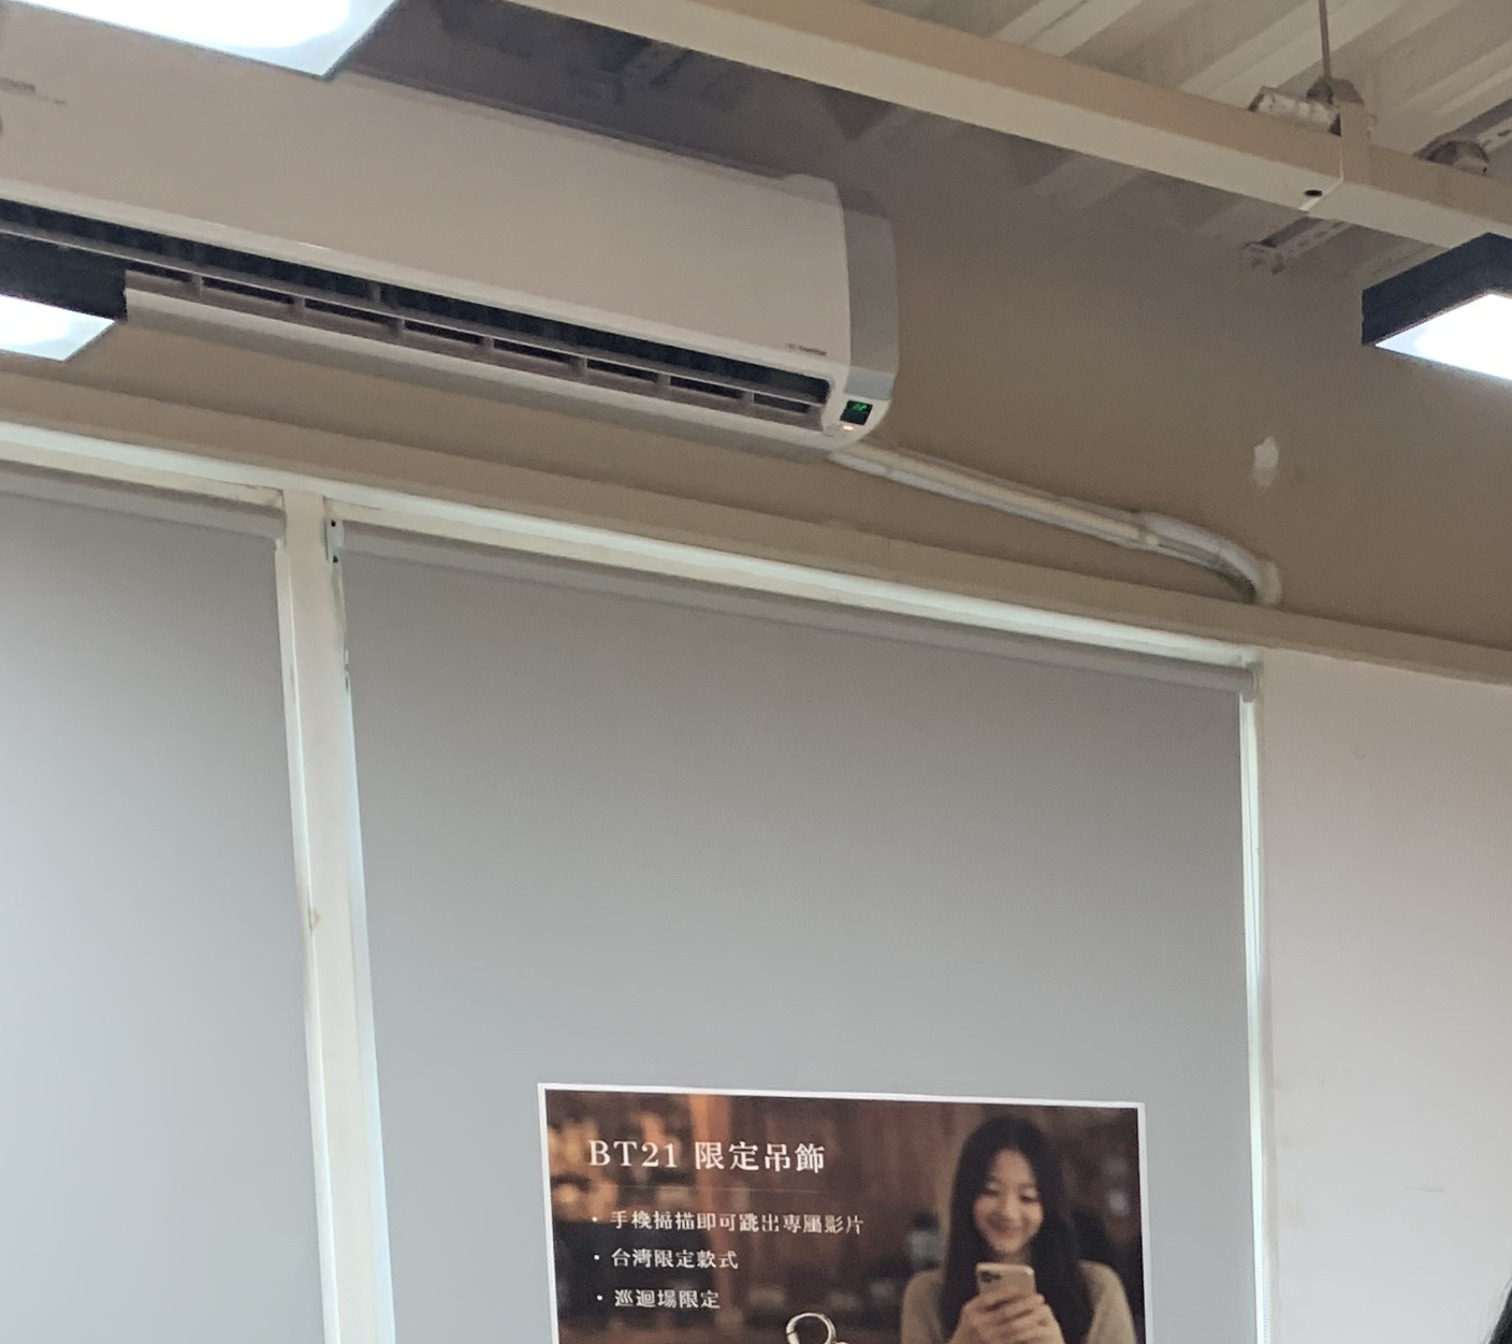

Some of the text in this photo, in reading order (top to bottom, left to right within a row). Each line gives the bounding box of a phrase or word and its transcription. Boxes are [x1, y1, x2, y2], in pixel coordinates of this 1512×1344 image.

[588, 1139, 825, 1173] BT21 限定吊飾
[610, 1210, 864, 1235] 手機掃描即可跳出專屬影片
[611, 1248, 739, 1270] 台灣限定款式
[614, 1289, 721, 1309] 巡迴場限定
